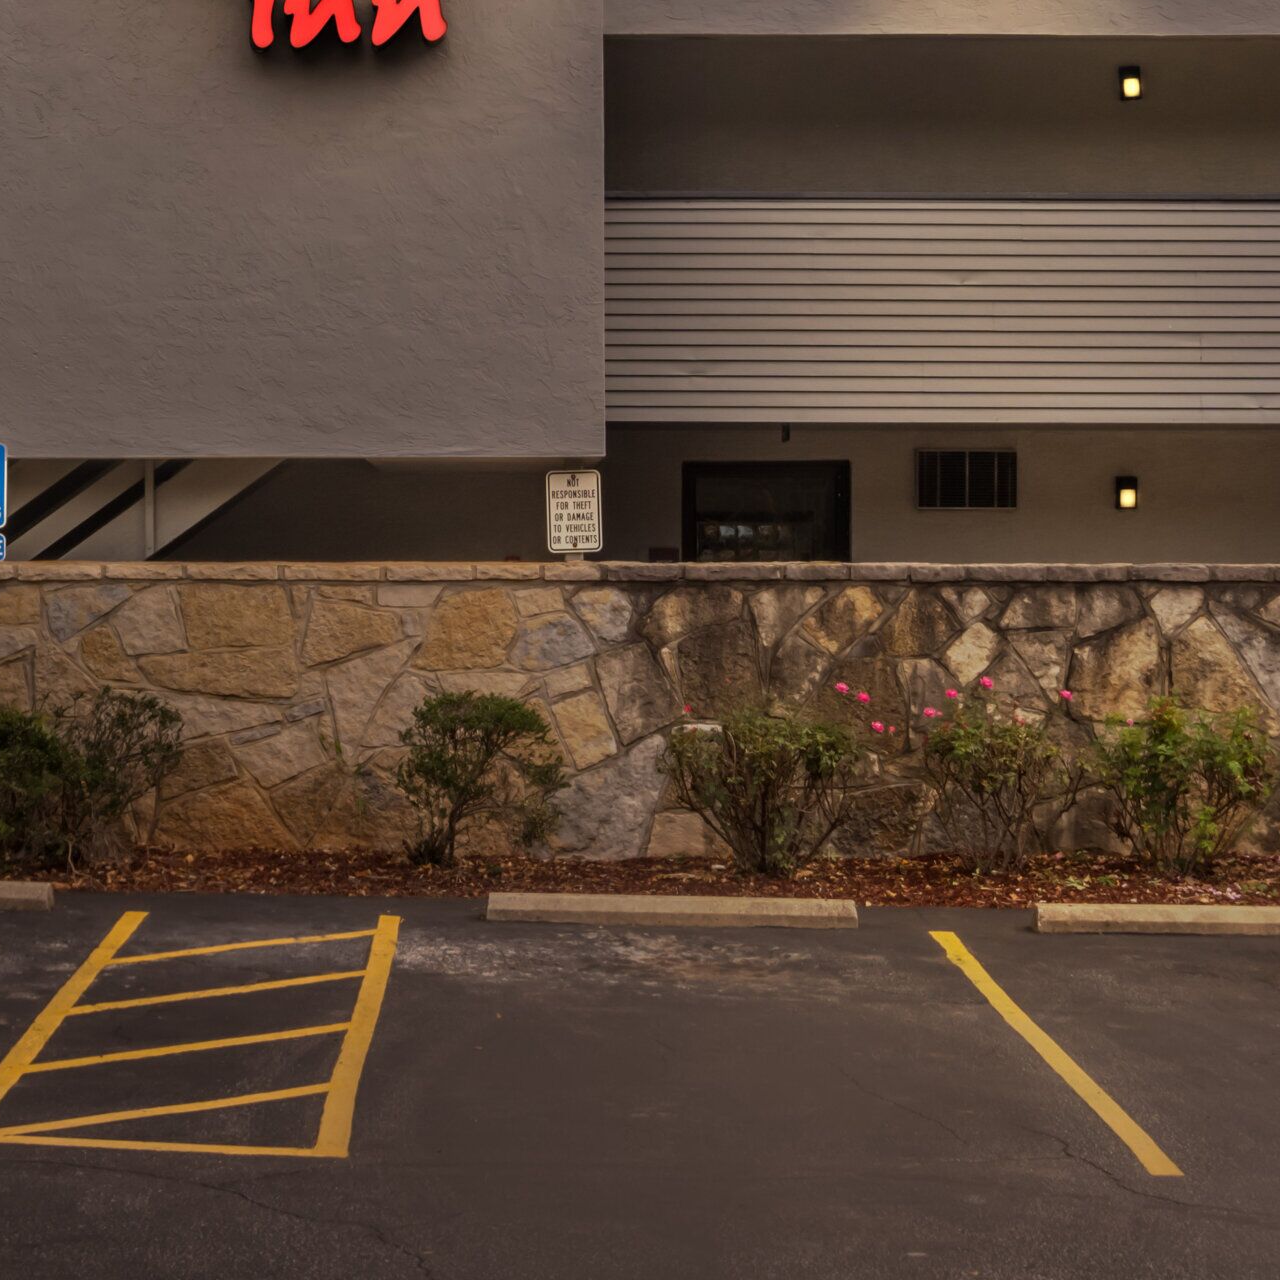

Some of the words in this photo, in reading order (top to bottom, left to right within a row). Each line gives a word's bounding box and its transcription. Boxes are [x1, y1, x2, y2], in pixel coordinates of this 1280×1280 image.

[567, 478, 579, 487] NOT
[552, 489, 595, 499] RESPONSIBLE
[556, 501, 568, 510] FOR
[573, 501, 591, 510] THEFT
[554, 513, 563, 522] OR
[567, 512, 594, 521] DAMAGE
[553, 524, 561, 533] TO
[565, 523, 596, 533] VEHICLES
[552, 535, 561, 544] OR
[565, 534, 597, 544] CONTENTS
